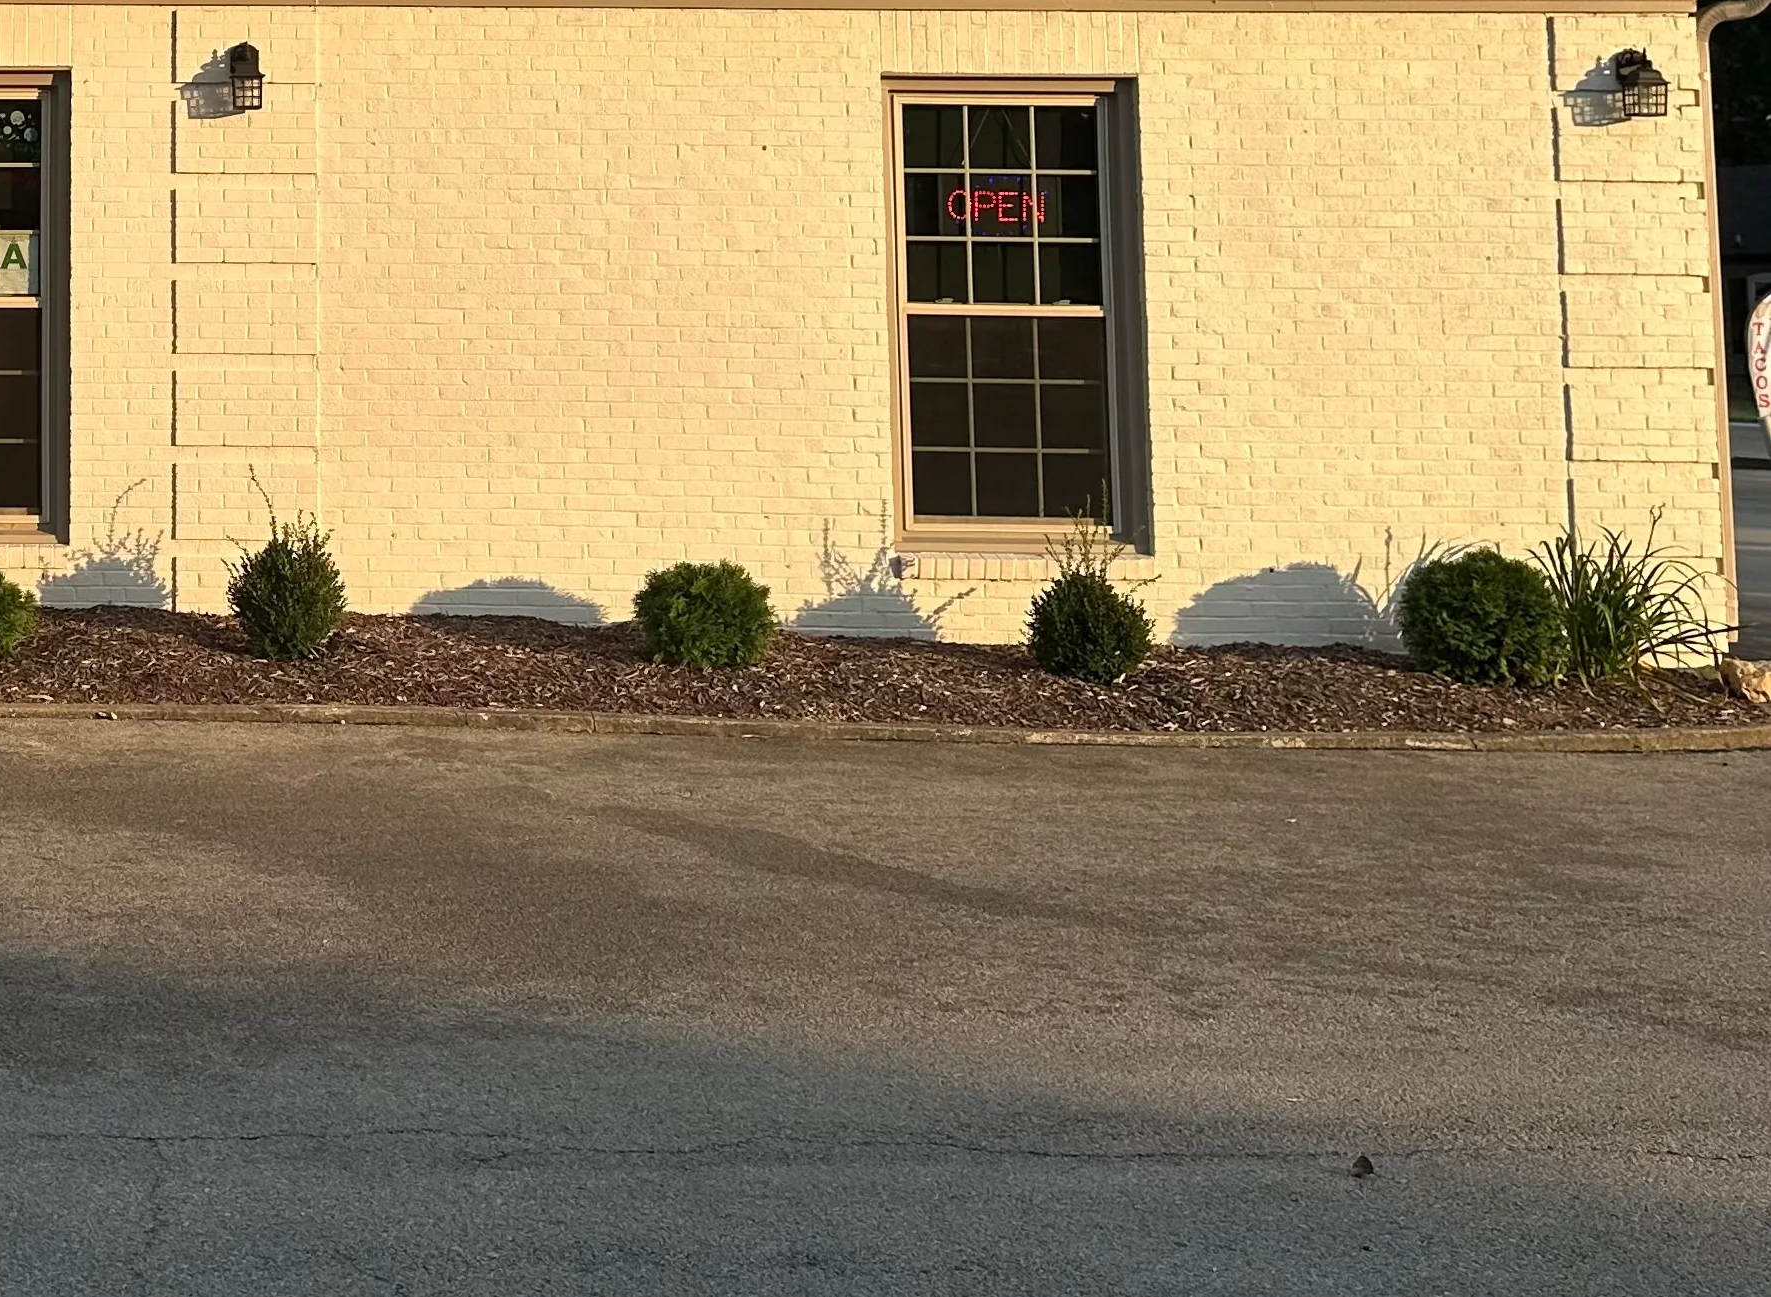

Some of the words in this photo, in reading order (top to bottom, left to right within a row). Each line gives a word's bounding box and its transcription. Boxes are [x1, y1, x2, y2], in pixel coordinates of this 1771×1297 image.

[947, 190, 1045, 223] OPEN
[0, 243, 27, 269] A
[1752, 322, 1770, 407] TACOS
